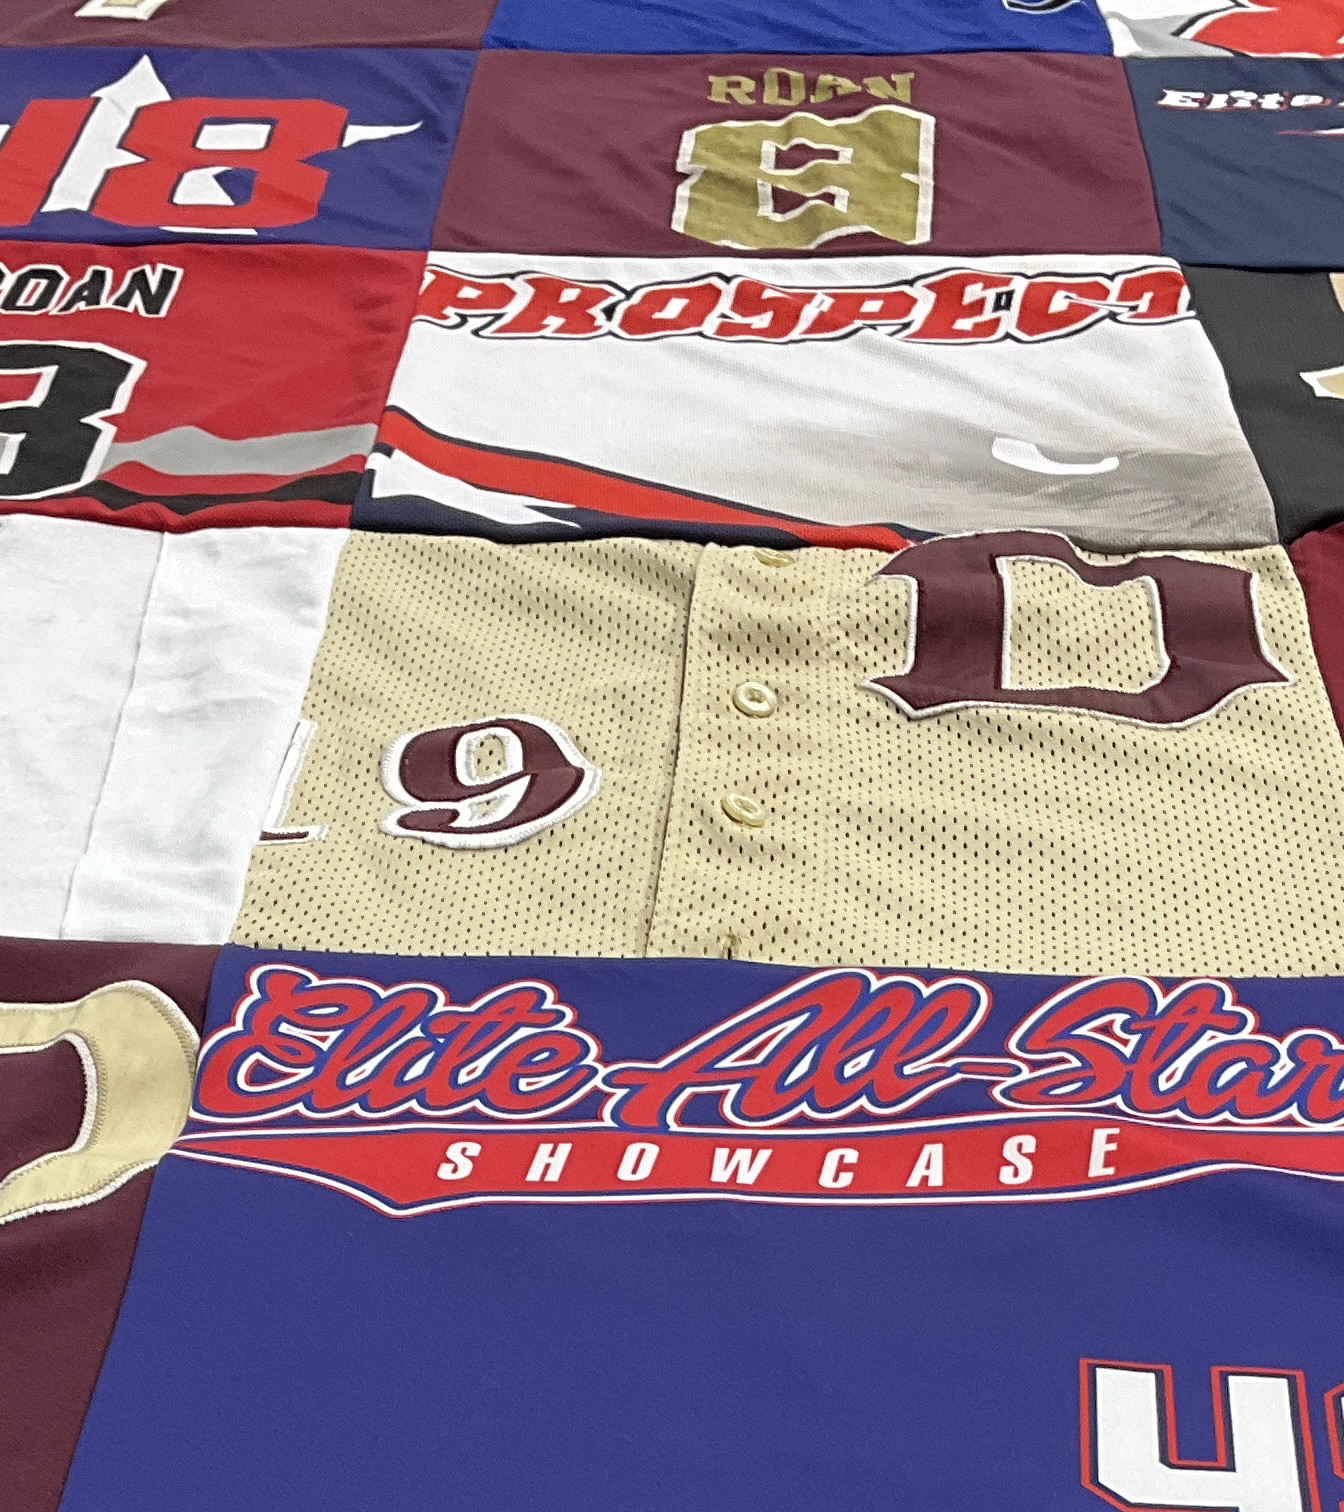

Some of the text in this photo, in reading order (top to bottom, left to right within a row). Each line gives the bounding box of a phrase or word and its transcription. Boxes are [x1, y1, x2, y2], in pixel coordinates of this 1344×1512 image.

[707, 70, 915, 106] ROAN
[1157, 88, 1331, 110] Elite
[864, 528, 1296, 729] D
[256, 714, 602, 850] 9
[188, 963, 606, 1125] Elite
[436, 1126, 1122, 1190] SHOWCASE
